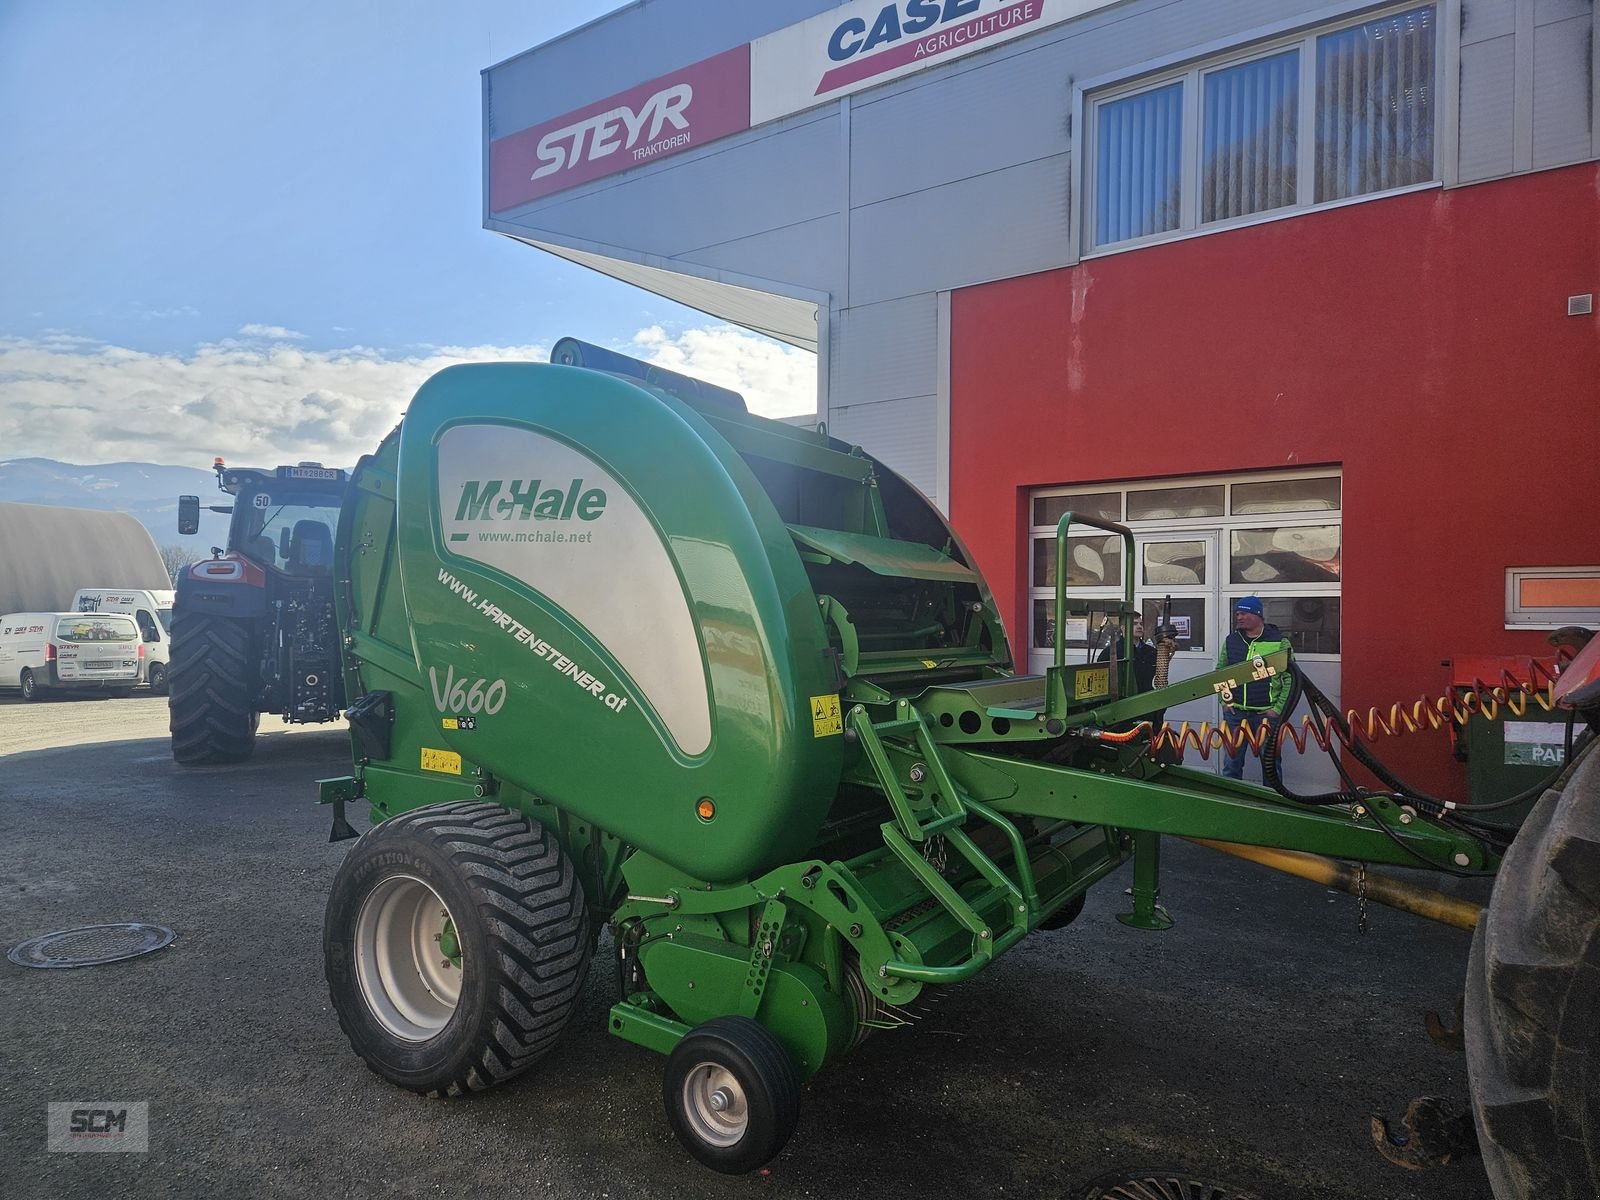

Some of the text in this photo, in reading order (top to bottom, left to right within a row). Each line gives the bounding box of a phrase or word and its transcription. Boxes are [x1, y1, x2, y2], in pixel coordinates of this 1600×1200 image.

[914, 3, 1033, 58] AGRICULTURE
[531, 83, 693, 181] STEYR
[632, 132, 691, 161] TRAKTOREN
[255, 496, 269, 507] 50
[455, 479, 607, 521] McHale
[478, 530, 592, 543] www.mchale.net
[429, 664, 507, 715] V660
